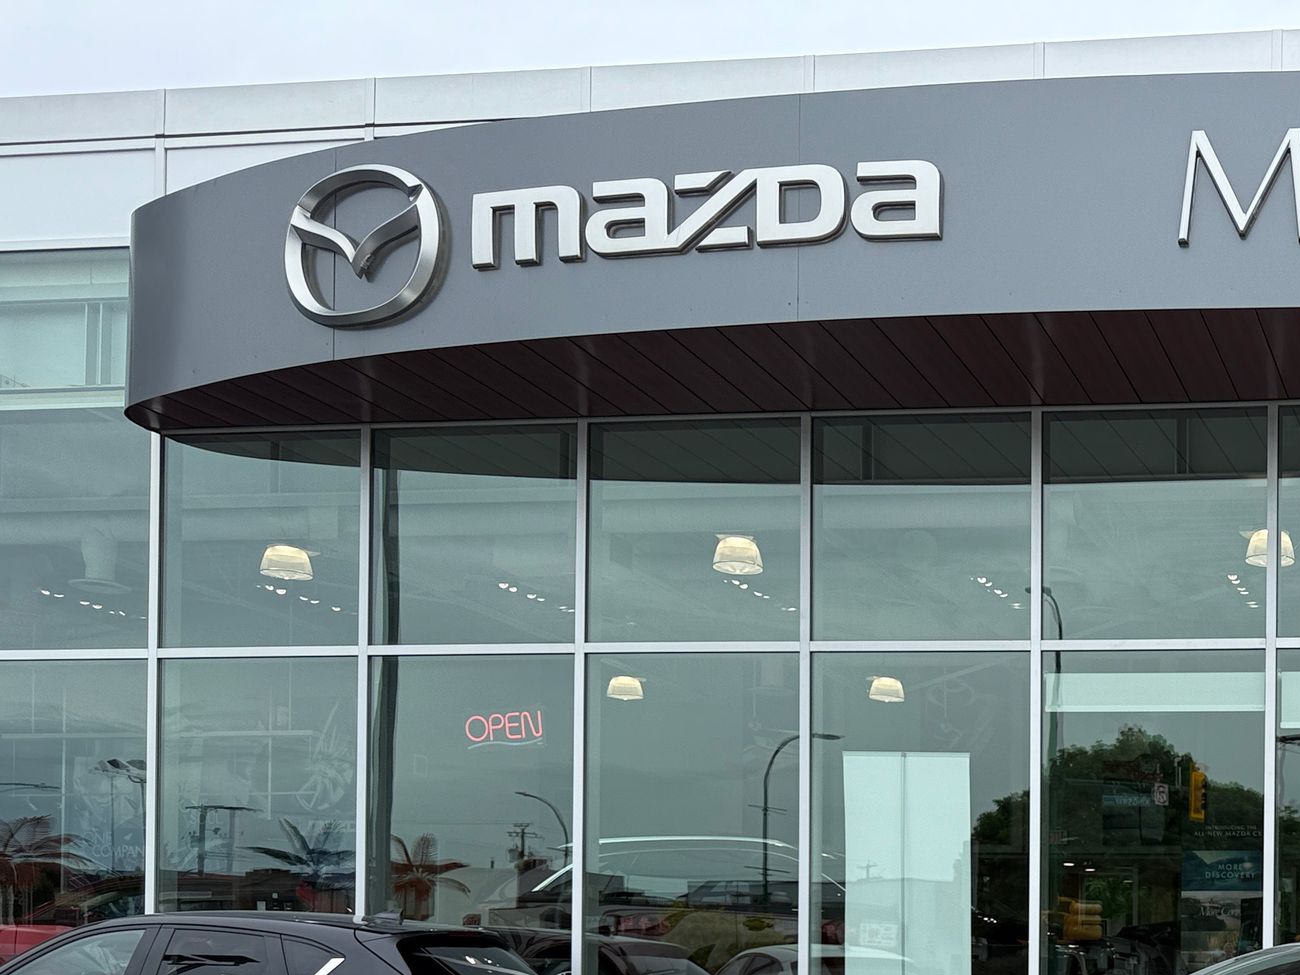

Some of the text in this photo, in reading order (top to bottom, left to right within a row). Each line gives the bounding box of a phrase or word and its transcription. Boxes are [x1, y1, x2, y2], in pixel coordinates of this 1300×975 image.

[465, 710, 543, 742] OPEN
[93, 844, 143, 858] COMPAN
[1205, 871, 1255, 879] DISCOVERY
